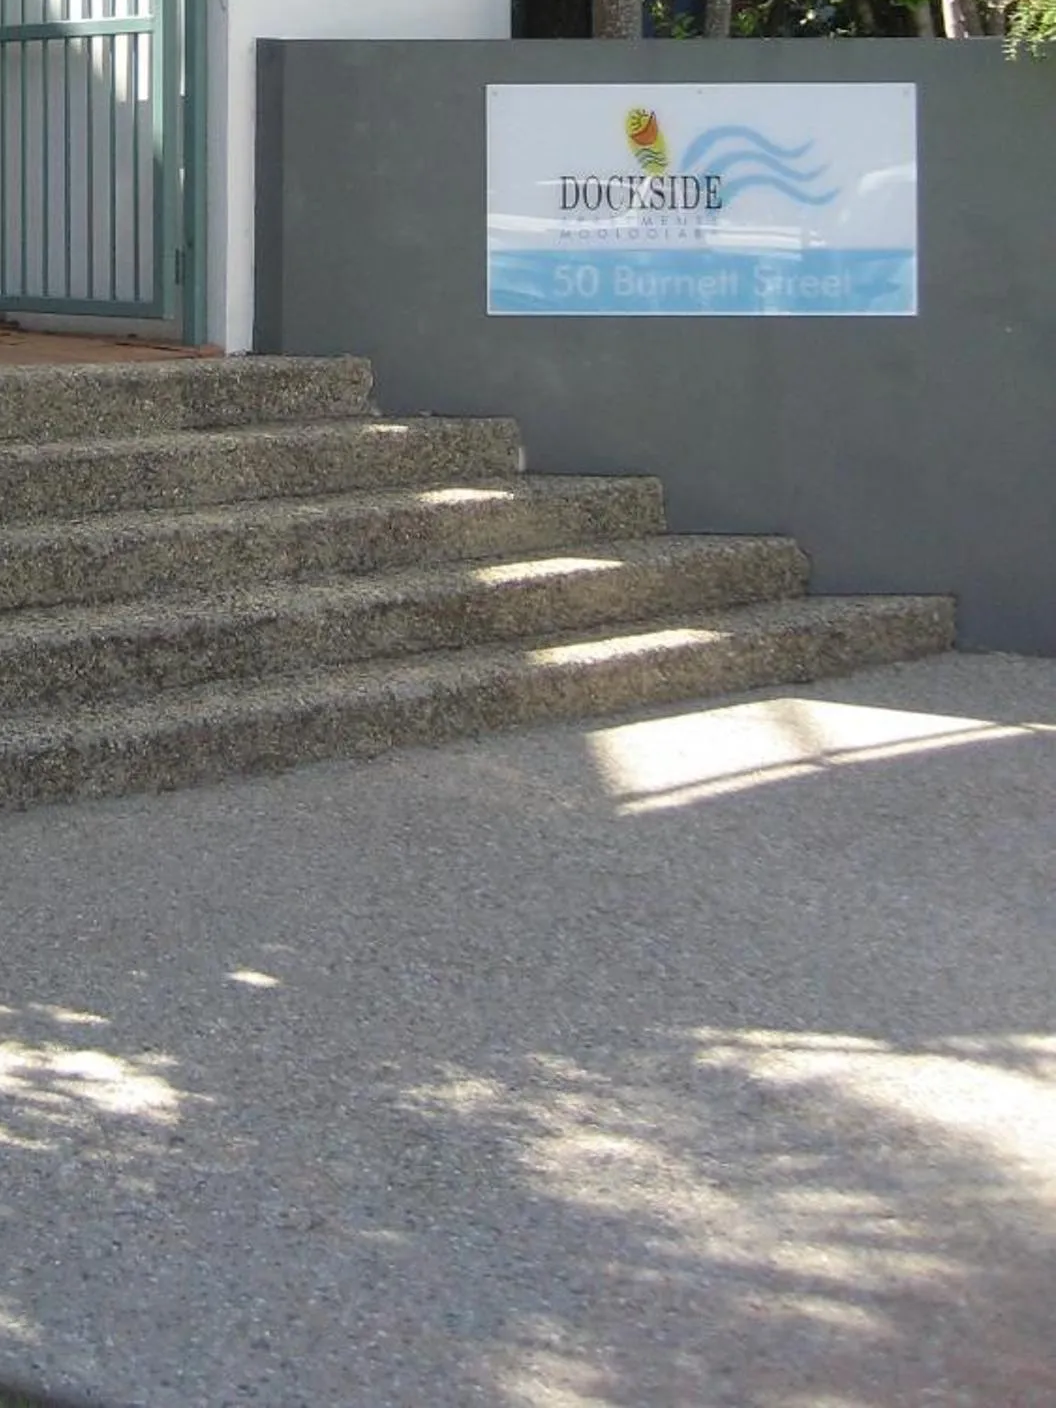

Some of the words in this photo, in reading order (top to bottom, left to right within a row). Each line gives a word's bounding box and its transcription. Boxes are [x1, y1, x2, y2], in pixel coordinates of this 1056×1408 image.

[559, 175, 723, 210] DOCKSIDE
[554, 264, 599, 297] 50
[613, 264, 739, 297] Burnett
[754, 264, 851, 298] Street
